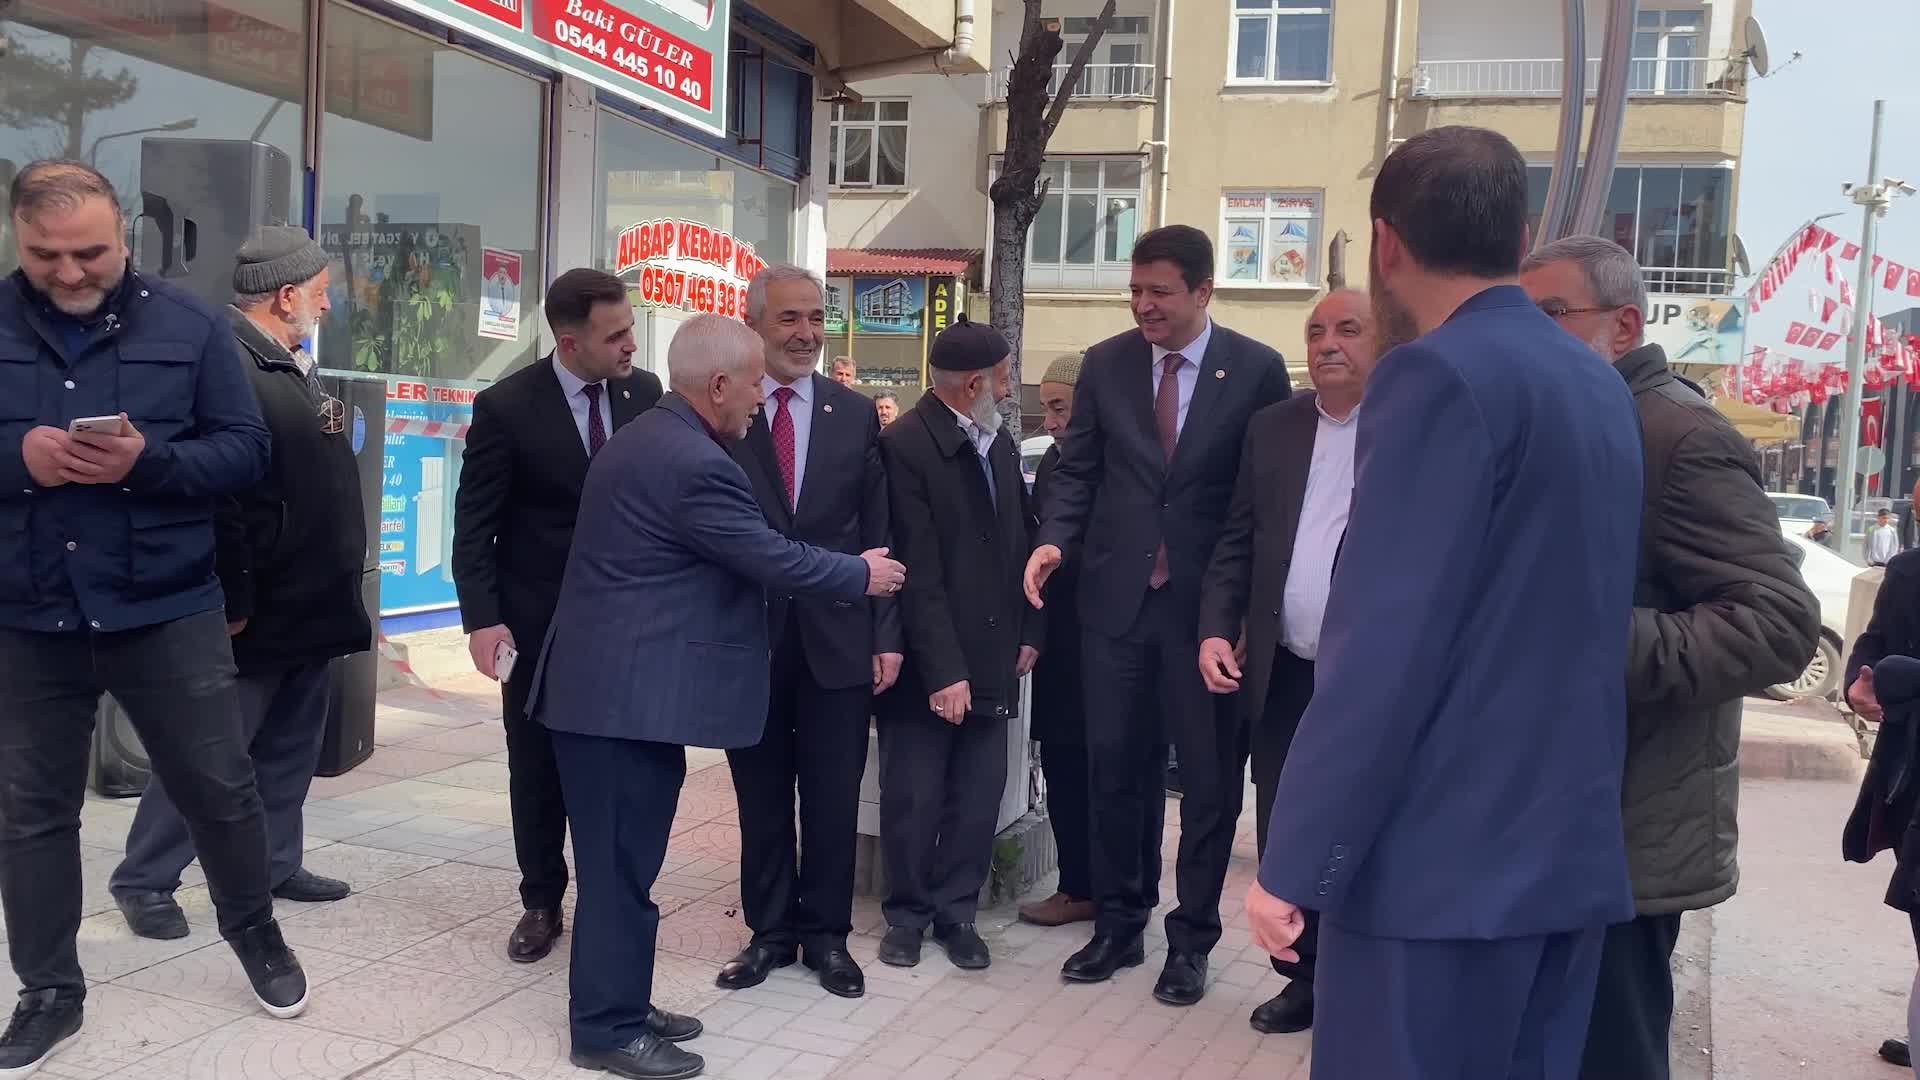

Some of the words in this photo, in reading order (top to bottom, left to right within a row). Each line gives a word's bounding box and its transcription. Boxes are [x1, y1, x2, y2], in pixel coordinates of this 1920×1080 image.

[554, 18, 608, 60] 0544
[612, 45, 649, 78] 445
[654, 63, 676, 90] 10
[680, 76, 702, 102] 40
[564, 0, 615, 33] Baki
[619, 22, 695, 70] GÜLER
[1227, 198, 1265, 209] EMLAK
[617, 220, 675, 272] AHBAP
[677, 221, 732, 270] KEBAP
[642, 266, 687, 307] 0507
[687, 276, 715, 314] 463
[718, 280, 736, 318] 38
[934, 283, 948, 337] ADE
[1646, 303, 1682, 325] UP
[385, 380, 428, 401] LER
